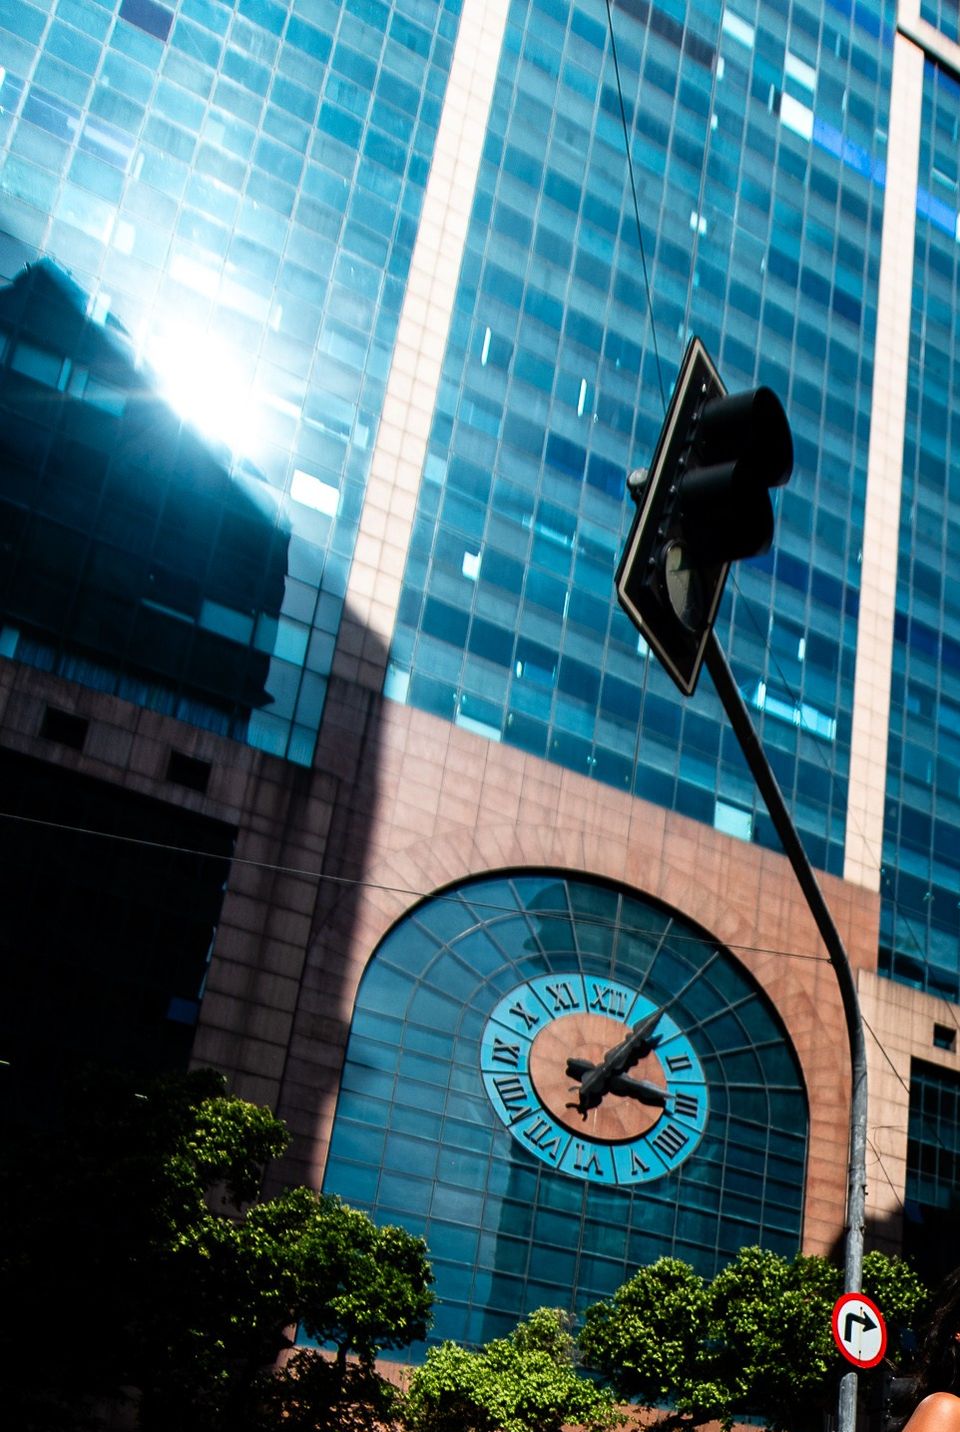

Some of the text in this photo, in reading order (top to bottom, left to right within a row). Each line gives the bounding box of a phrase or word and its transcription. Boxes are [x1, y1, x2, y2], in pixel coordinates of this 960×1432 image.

[546, 982, 580, 1011] XI
[590, 983, 627, 1017] XII
[509, 1002, 539, 1030] X
[492, 1038, 520, 1067] IX
[665, 1053, 692, 1073] II
[493, 1075, 532, 1121] VIII
[675, 1093, 698, 1119] III
[524, 1116, 561, 1160] VII
[653, 1123, 689, 1159] IIII
[574, 1145, 604, 1176] VI
[630, 1147, 649, 1175] V
